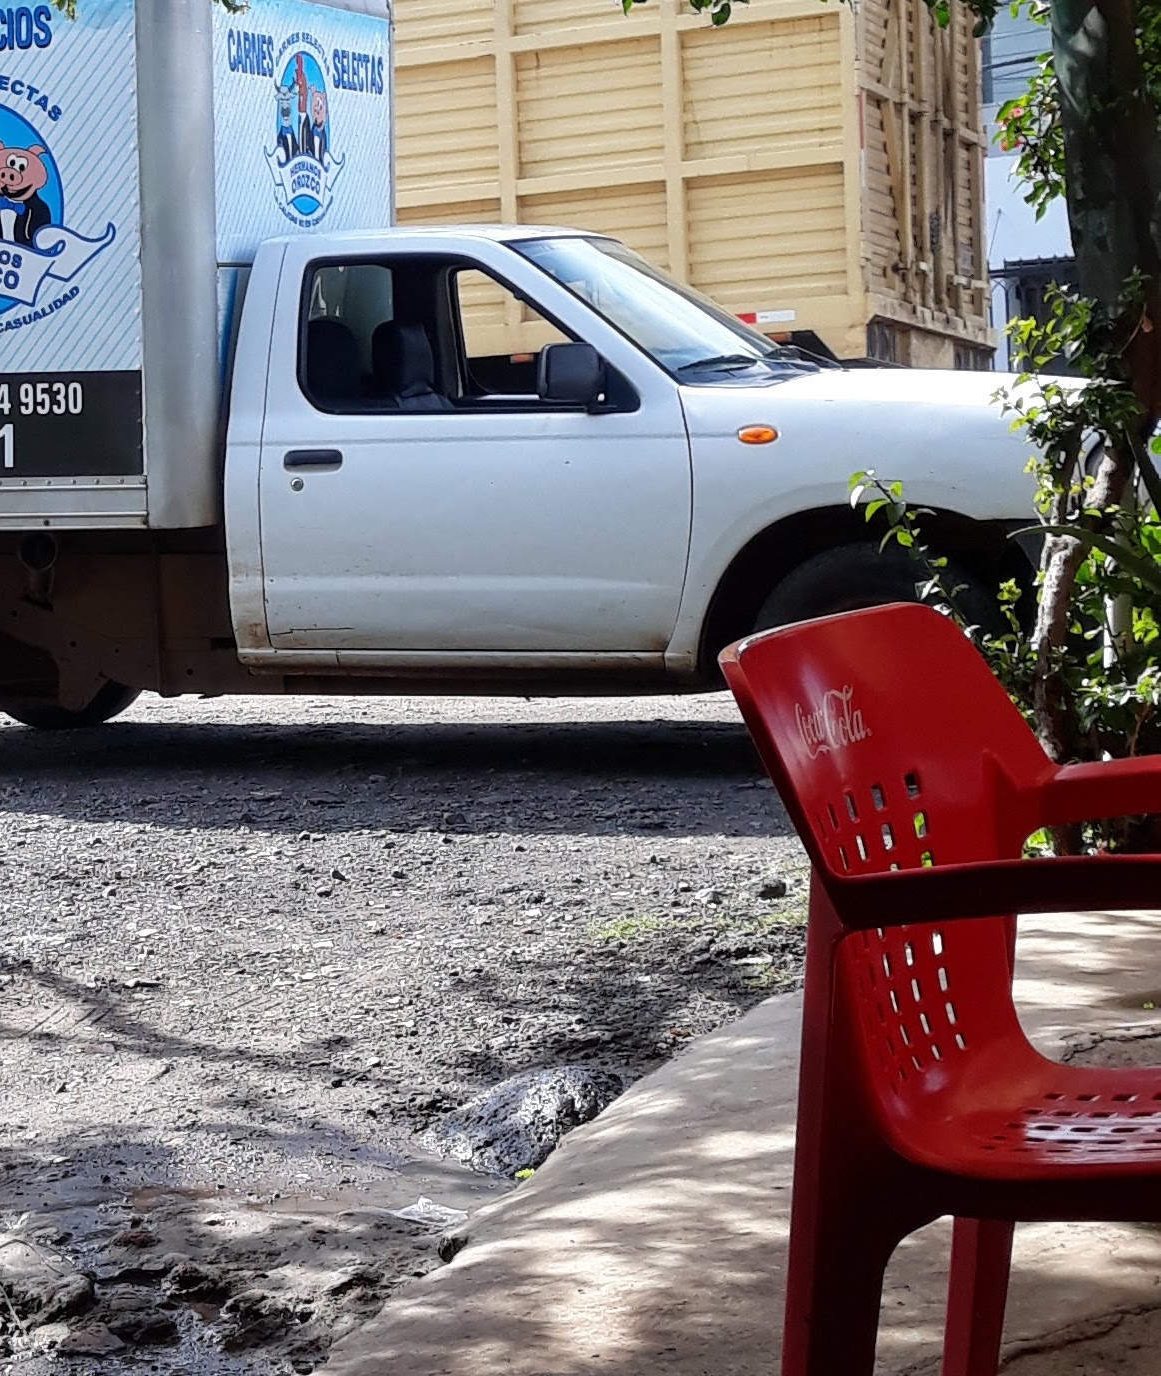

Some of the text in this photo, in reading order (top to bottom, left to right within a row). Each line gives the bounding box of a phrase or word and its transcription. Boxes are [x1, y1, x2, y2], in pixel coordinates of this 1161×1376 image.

[227, 27, 385, 96] CARNES SELECTAS
[19, 381, 84, 416] 9530
